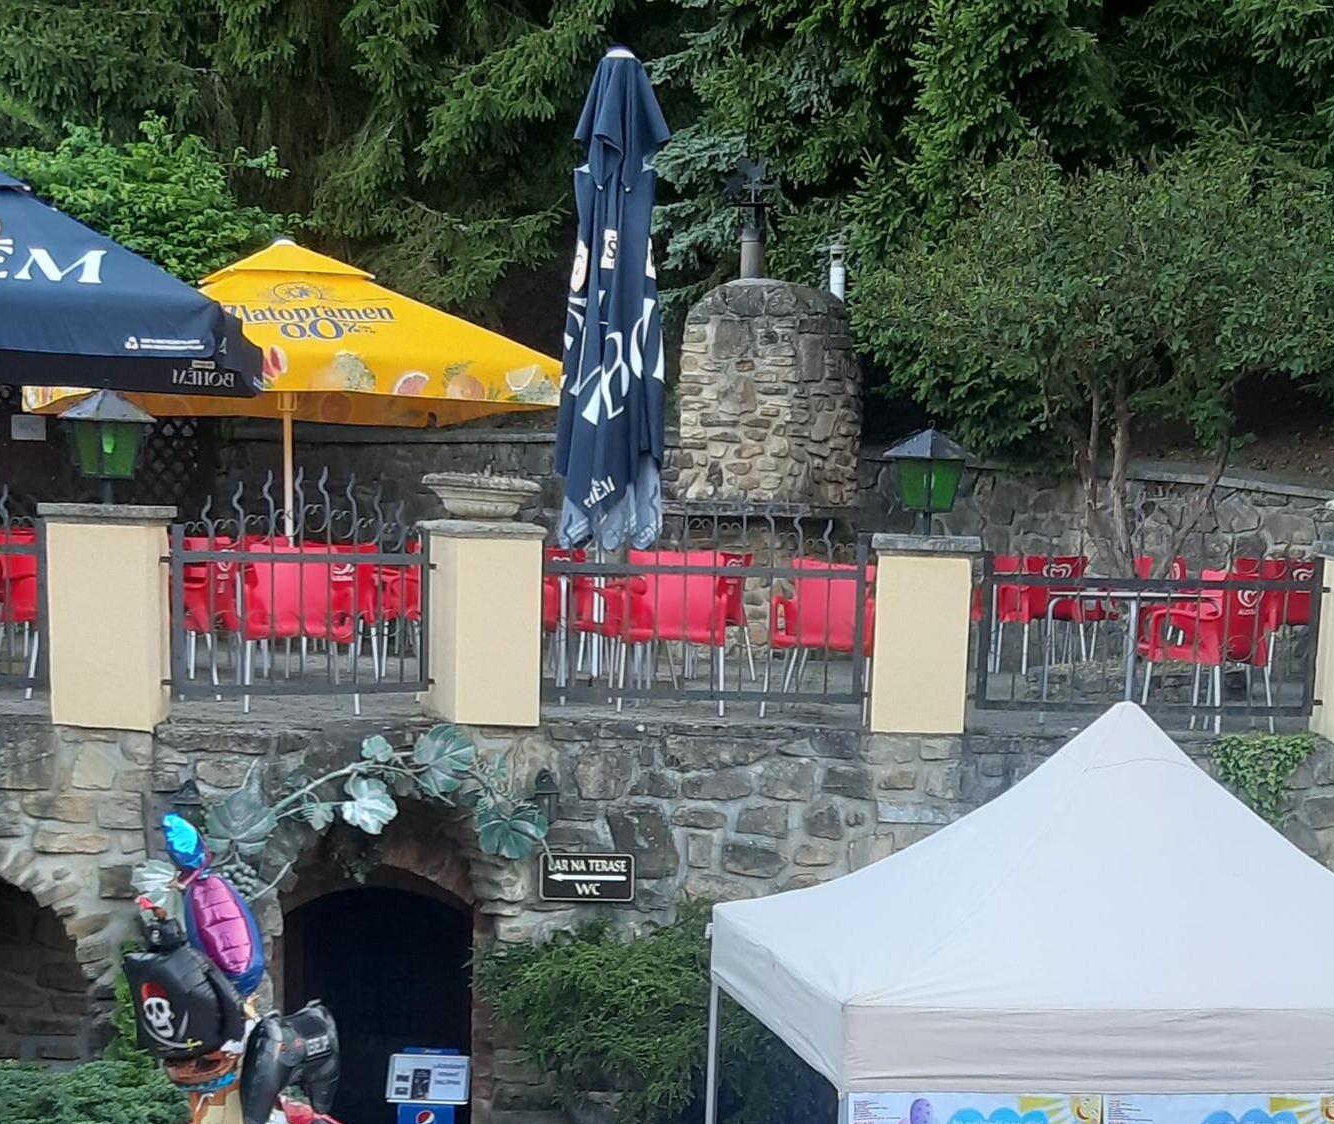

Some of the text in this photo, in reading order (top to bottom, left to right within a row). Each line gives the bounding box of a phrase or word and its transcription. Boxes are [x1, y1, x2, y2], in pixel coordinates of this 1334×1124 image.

[570, 859, 587, 872] NA
[587, 859, 628, 873] TERASE
[574, 882, 601, 896] WC
